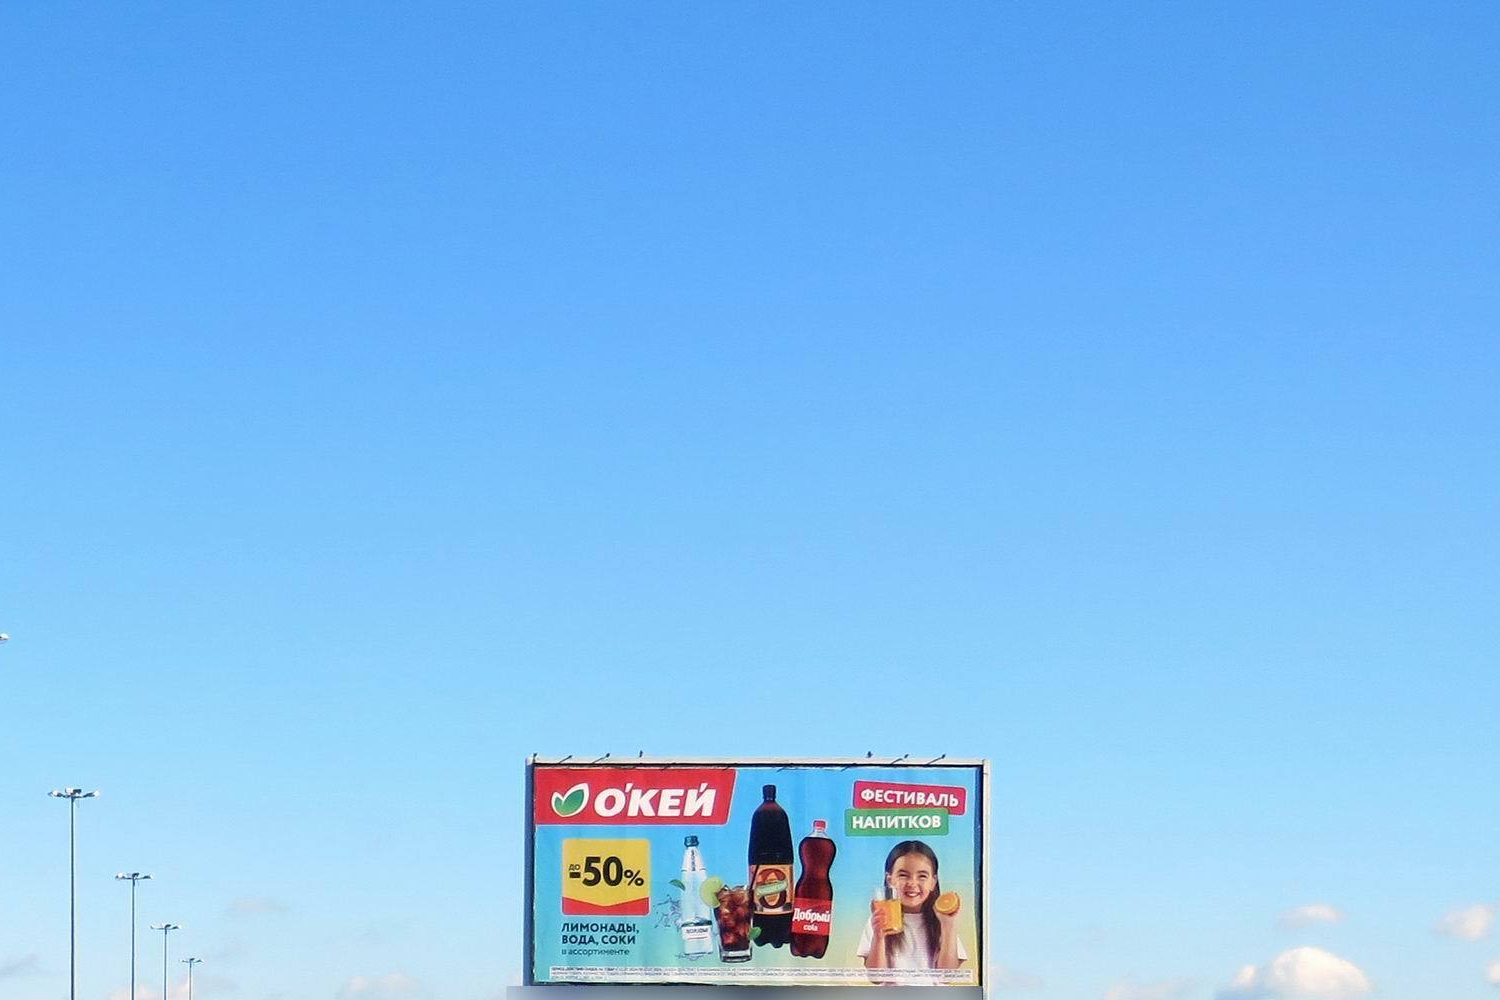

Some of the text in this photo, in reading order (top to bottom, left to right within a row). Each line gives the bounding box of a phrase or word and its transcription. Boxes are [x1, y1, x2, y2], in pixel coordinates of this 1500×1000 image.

[594, 783, 716, 817] О'КЕЙ
[860, 788, 959, 807] ФЕСТИВАЛЬ
[852, 815, 941, 829] НАПИТКОВ
[569, 856, 644, 887] -50%
[792, 908, 832, 923] Добрый
[562, 923, 639, 934] ЛИМОНАДЫ,
[562, 935, 636, 945] ВОДА, СОКИ
[568, 948, 630, 956] ассортименте
